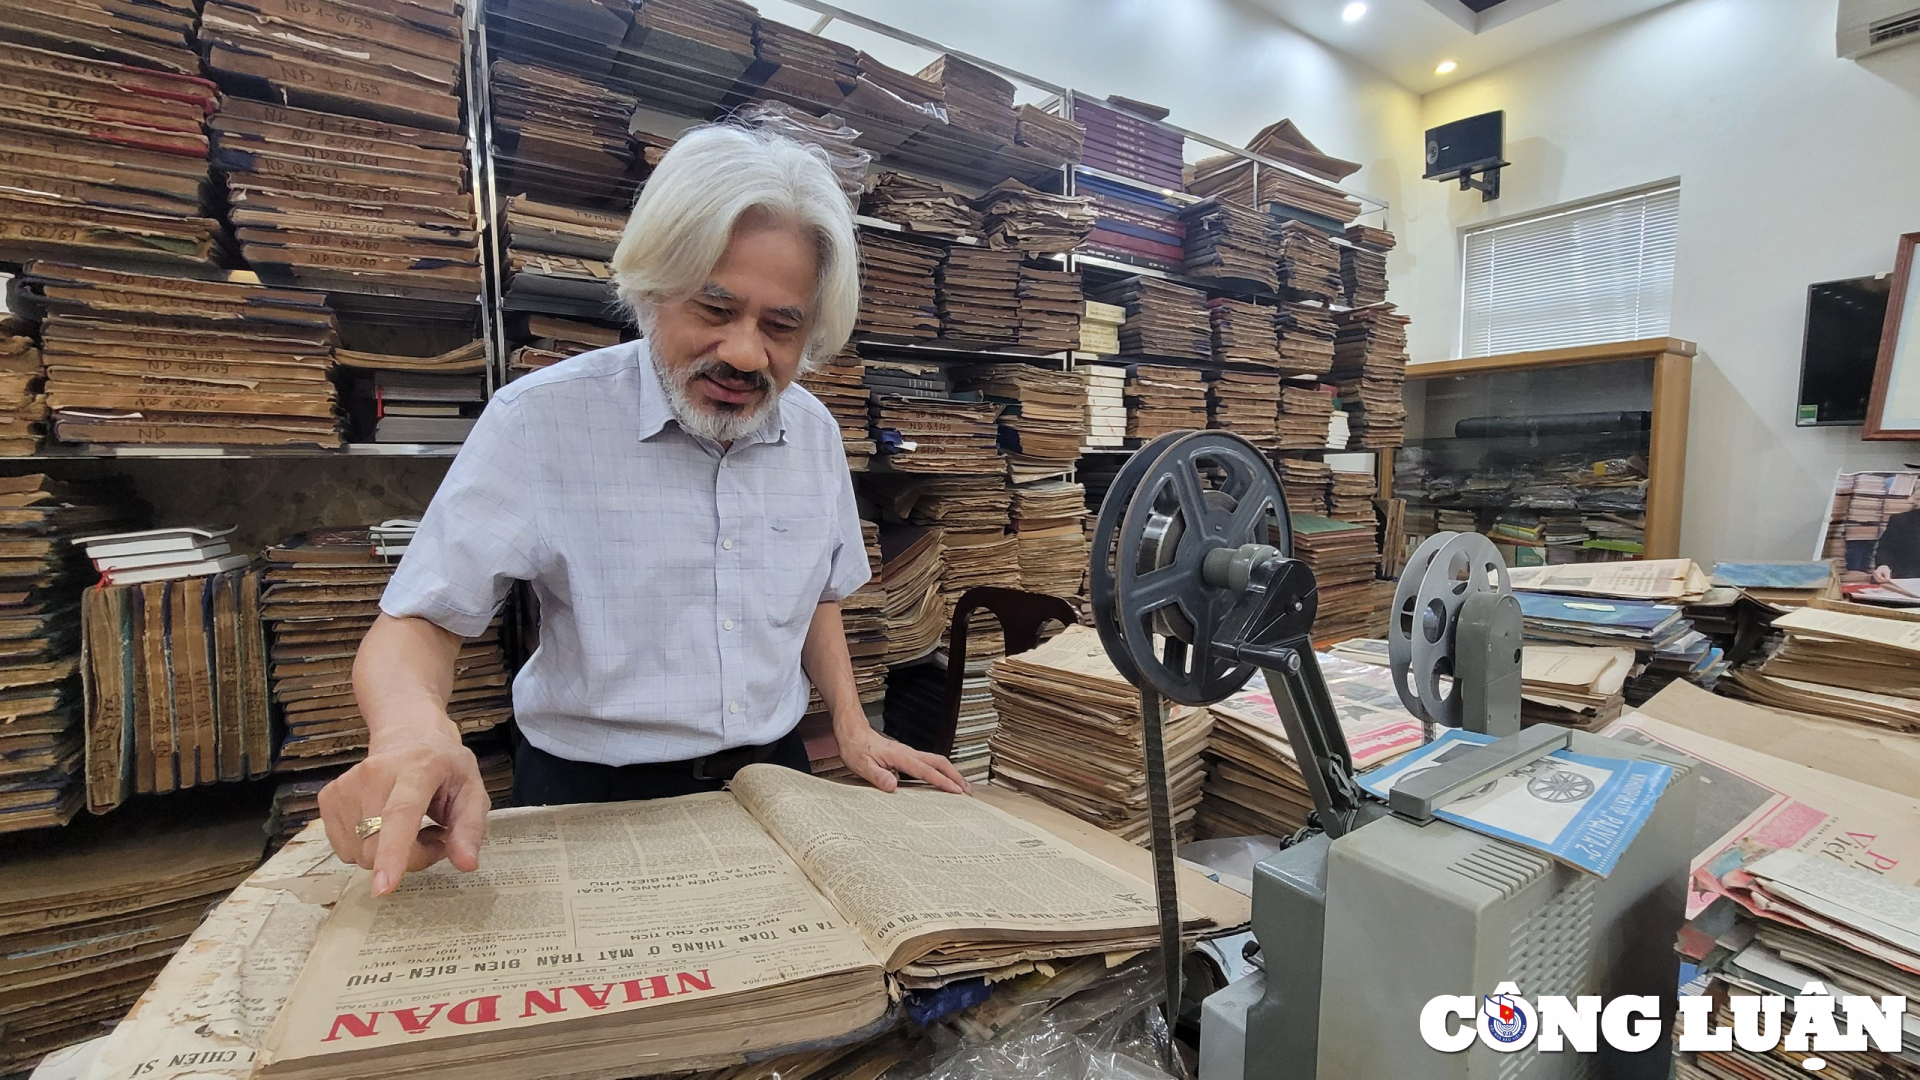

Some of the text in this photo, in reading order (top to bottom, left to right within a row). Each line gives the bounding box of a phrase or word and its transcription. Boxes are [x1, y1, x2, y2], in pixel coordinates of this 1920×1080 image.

[286, 0, 373, 30] ND 1-6/58
[281, 66, 381, 96] ND 1-6/59
[264, 107, 287, 122] ND
[292, 131, 314, 141] ND
[305, 149, 330, 160] ND
[266, 160, 284, 170] ND
[320, 220, 342, 230] ND
[310, 236, 330, 244] ND
[310, 254, 330, 262] ND
[148, 360, 172, 370] ND
[139, 428, 166, 439] ND
[1820, 831, 1877, 862] Việt
[45, 908, 77, 921] ND
[815, 920, 836, 930] TA
[611, 970, 648, 979] TRUNG
[656, 965, 686, 973] QUAN
[458, 987, 484, 995] LAO
[519, 969, 716, 1018] NHÂN
[320, 995, 501, 1042] DÂN
[166, 1050, 238, 1068] CHIẾN
[128, 1059, 160, 1080] SĨ
